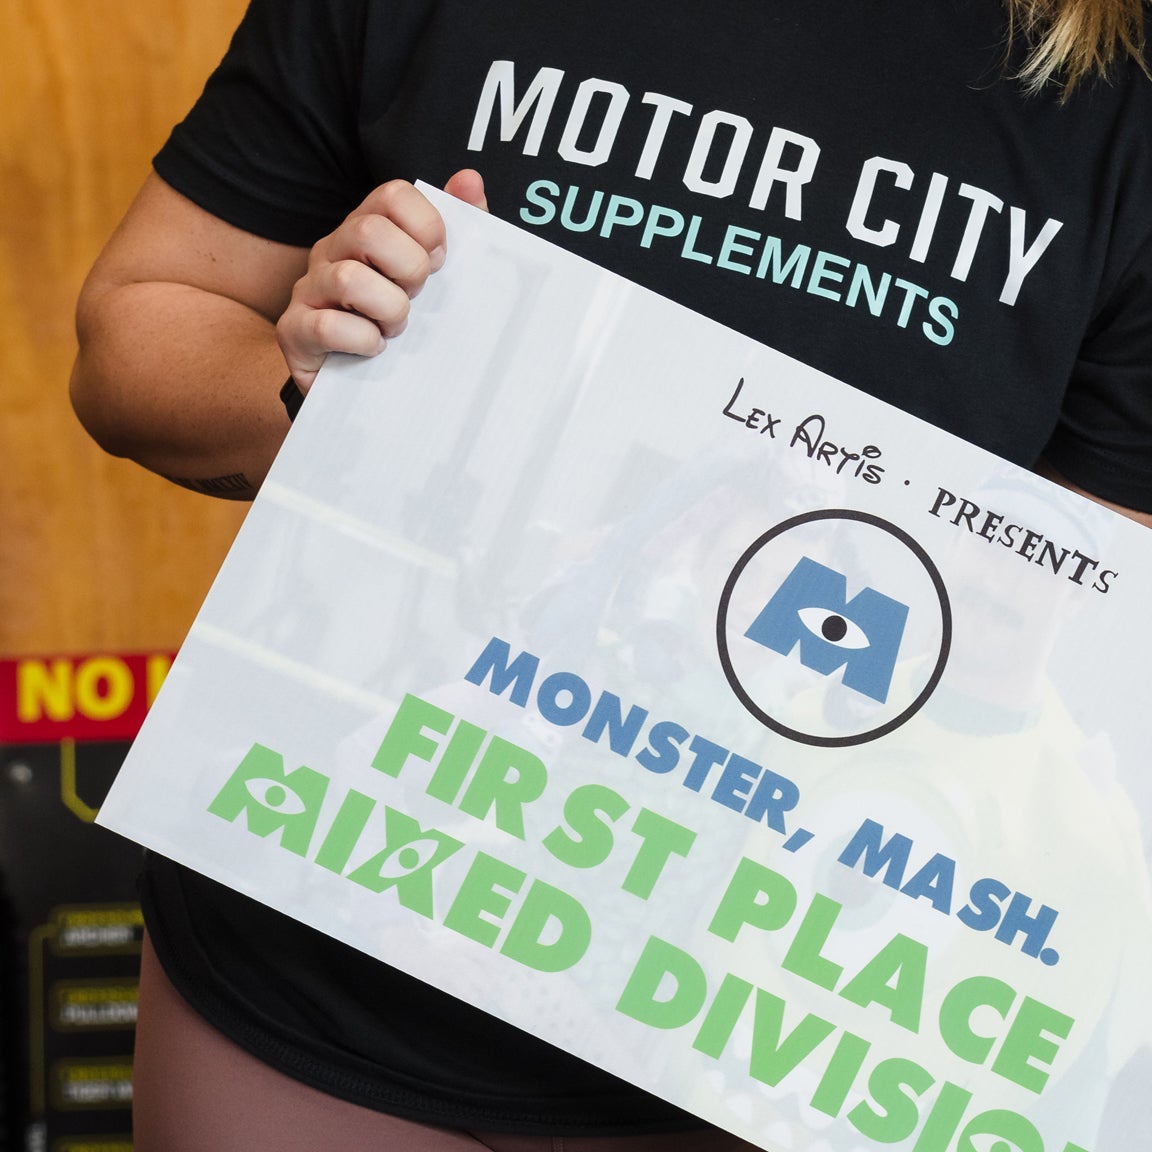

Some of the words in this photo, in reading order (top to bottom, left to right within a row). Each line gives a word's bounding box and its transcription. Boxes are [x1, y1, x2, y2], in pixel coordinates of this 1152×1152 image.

[467, 60, 821, 221] MOTOR
[846, 156, 1063, 306] CITY
[520, 180, 958, 345] SUPPLEMENTS
[929, 488, 1118, 593] PRESENTS
[18, 657, 134, 722] NO
[465, 638, 812, 852] MONSTER,
[839, 820, 1058, 965] MASH.
[209, 744, 590, 971] MIXED
[373, 694, 695, 899] FIRST
[709, 858, 1073, 1093] PLACE
